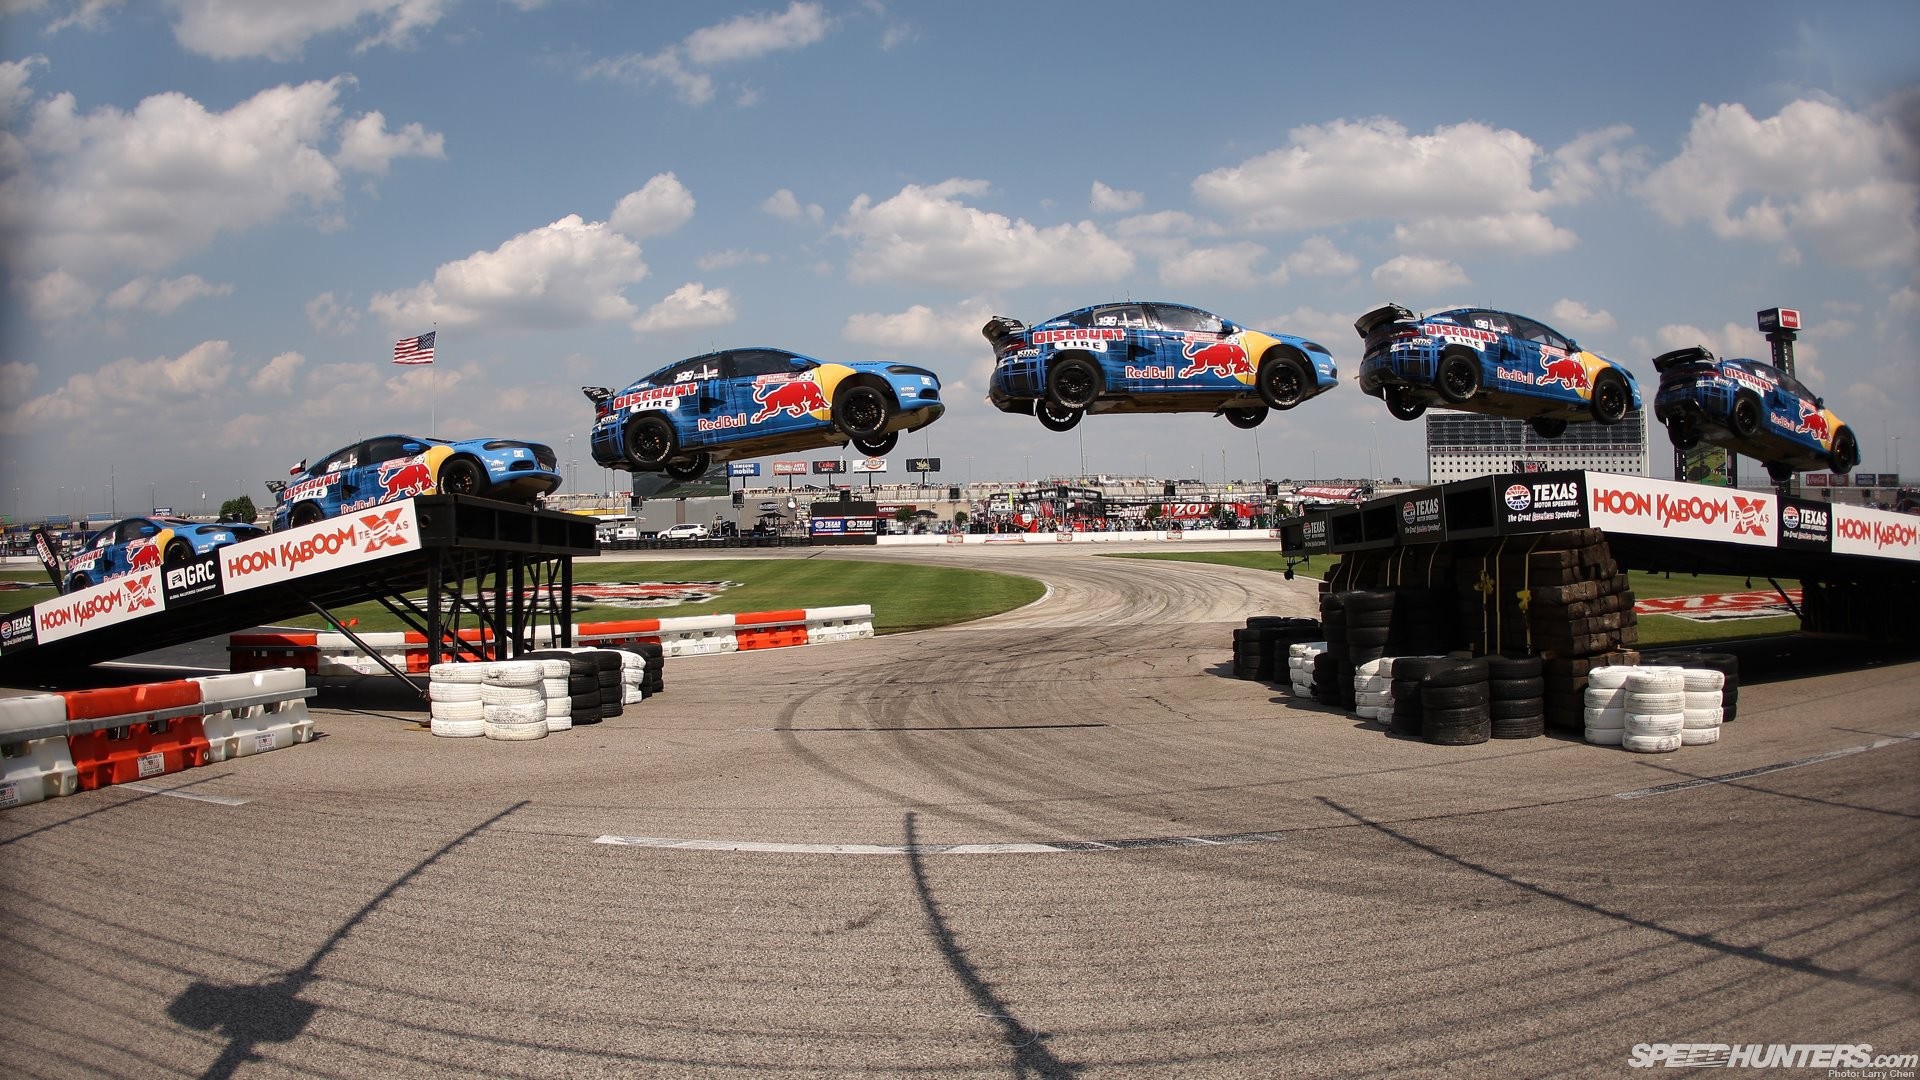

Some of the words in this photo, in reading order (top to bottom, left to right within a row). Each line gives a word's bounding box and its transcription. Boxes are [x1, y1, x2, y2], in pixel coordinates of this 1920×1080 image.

[1033, 328, 1126, 345] DISCOUNT
[1425, 323, 1499, 344] DISCOUNT
[1450, 336, 1480, 348] TIRE
[1061, 340, 1101, 350] TIRE
[1723, 367, 1774, 393] DISCOUNT
[613, 382, 698, 410] DISCOUNT
[636, 399, 673, 410] TIRE
[284, 472, 341, 501] DISCOUNT
[297, 488, 323, 500] TIRE
[1533, 482, 1578, 501] TEXAS
[1416, 497, 1439, 516] TEXAS
[1593, 488, 1651, 517] HOON
[1656, 493, 1728, 528] KABOOM
[1311, 521, 1325, 533] TEXAS
[1518, 513, 1531, 522] Great
[1800, 509, 1827, 526] TEXAS
[1837, 517, 1871, 540] HOON
[1874, 521, 1917, 550] KABOOM
[67, 548, 104, 571] DISCOUNT
[227, 547, 276, 578] HOON
[280, 523, 357, 572] KABOOM
[186, 560, 215, 586] GRC
[40, 606, 71, 631] HOON
[73, 587, 122, 627] KABOOM
[12, 615, 32, 631] TEXAS
